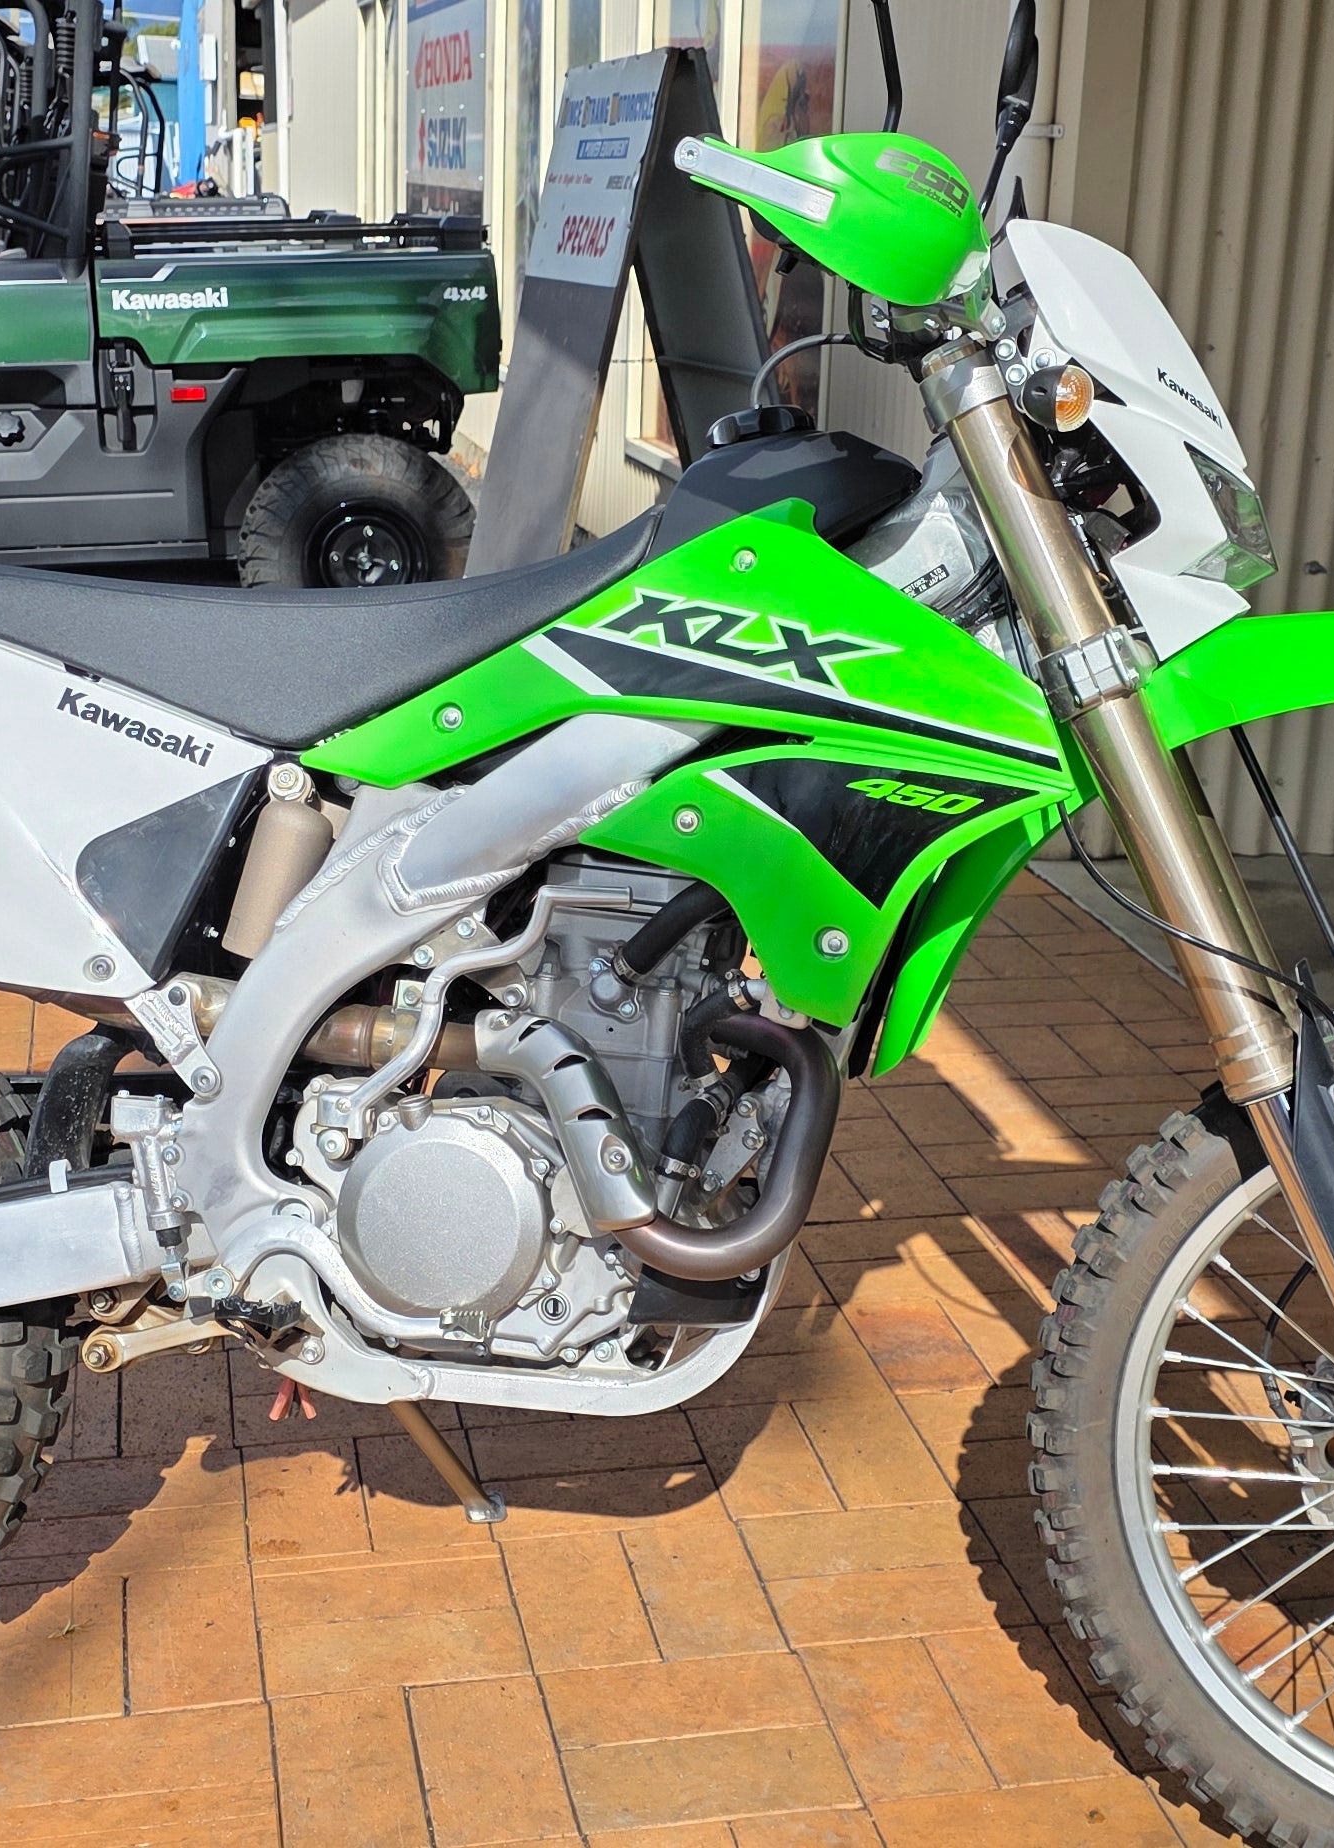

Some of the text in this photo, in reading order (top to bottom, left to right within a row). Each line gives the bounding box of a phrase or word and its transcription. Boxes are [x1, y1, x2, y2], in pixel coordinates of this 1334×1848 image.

[424, 30, 473, 88] HONDA
[428, 117, 466, 170] SUZUKI
[875, 147, 969, 210] EGO
[557, 215, 615, 258] SPECIALS
[112, 287, 229, 311] Kawasaki
[443, 286, 488, 302] 4x4
[1157, 367, 1223, 429] Kawasaki
[601, 590, 879, 691] KLX
[56, 687, 214, 767] Kawasaki
[846, 779, 985, 815] 450
